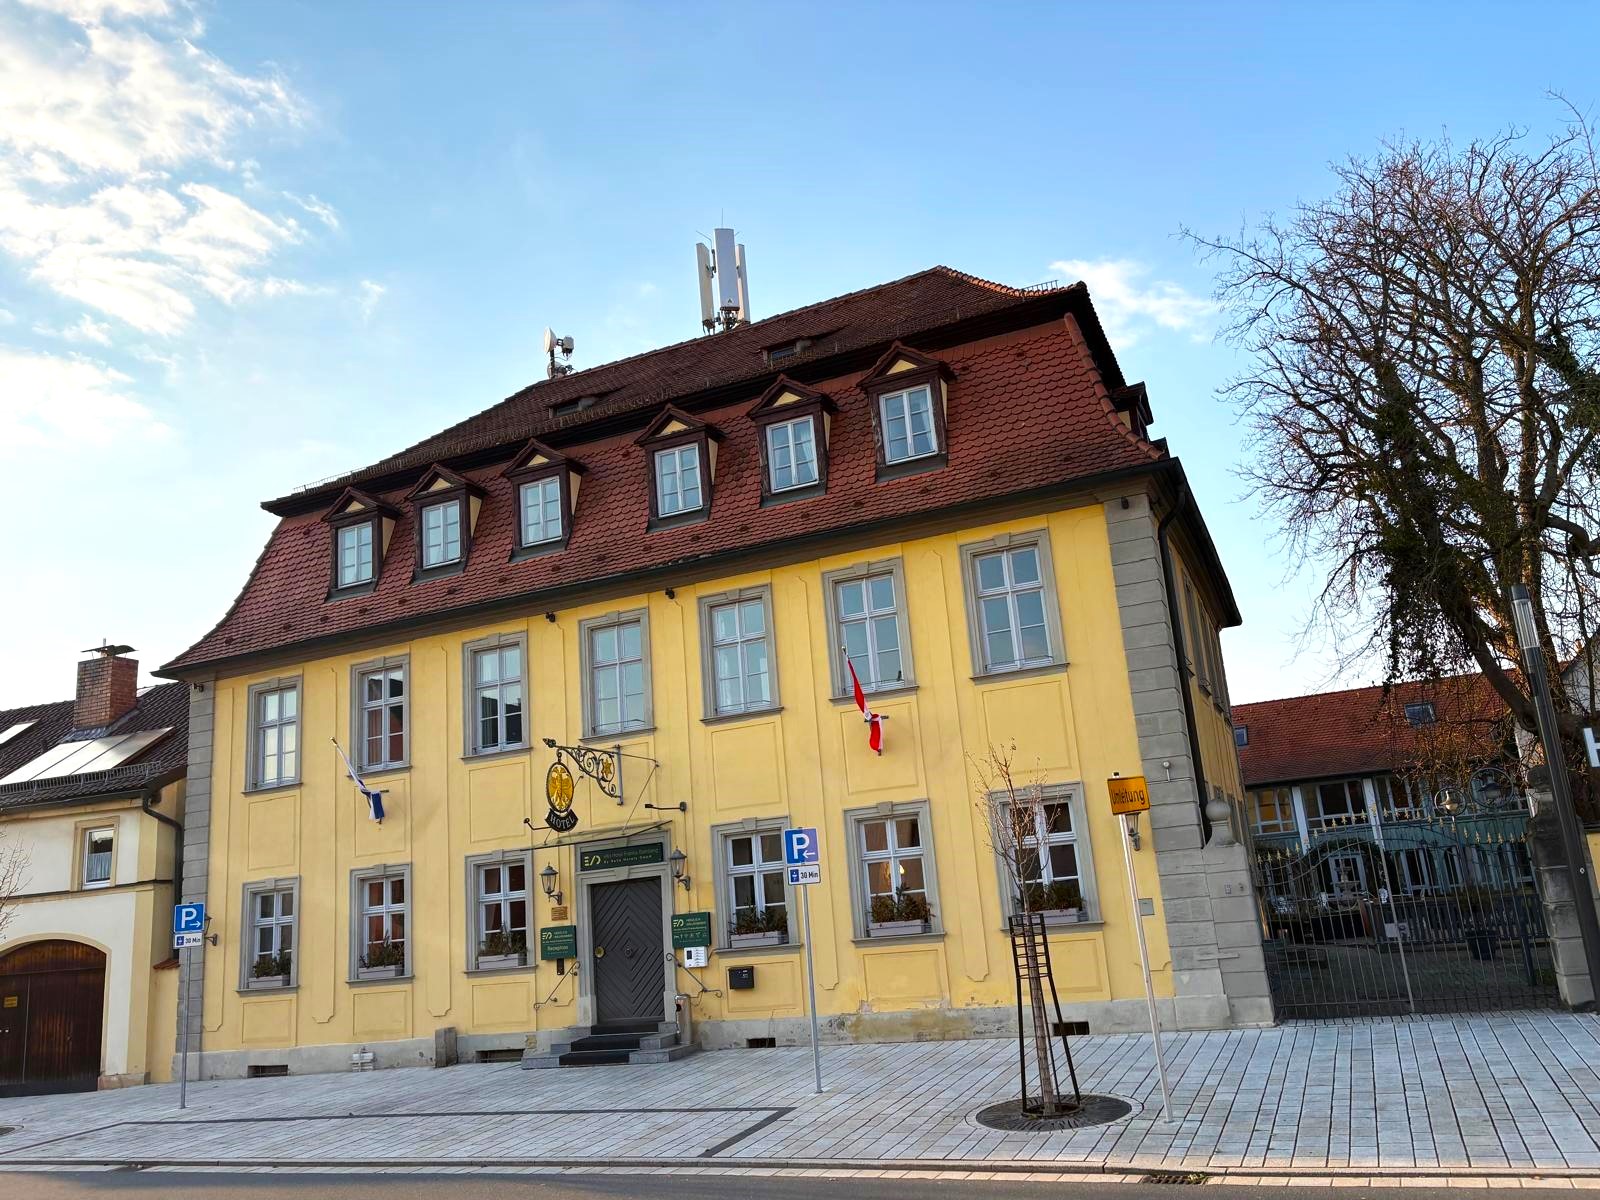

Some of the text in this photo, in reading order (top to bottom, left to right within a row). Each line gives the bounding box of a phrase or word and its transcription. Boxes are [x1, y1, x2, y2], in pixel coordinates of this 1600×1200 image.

[551, 814, 575, 829] HOTEL
[792, 834, 809, 859] P
[181, 908, 197, 928] P
